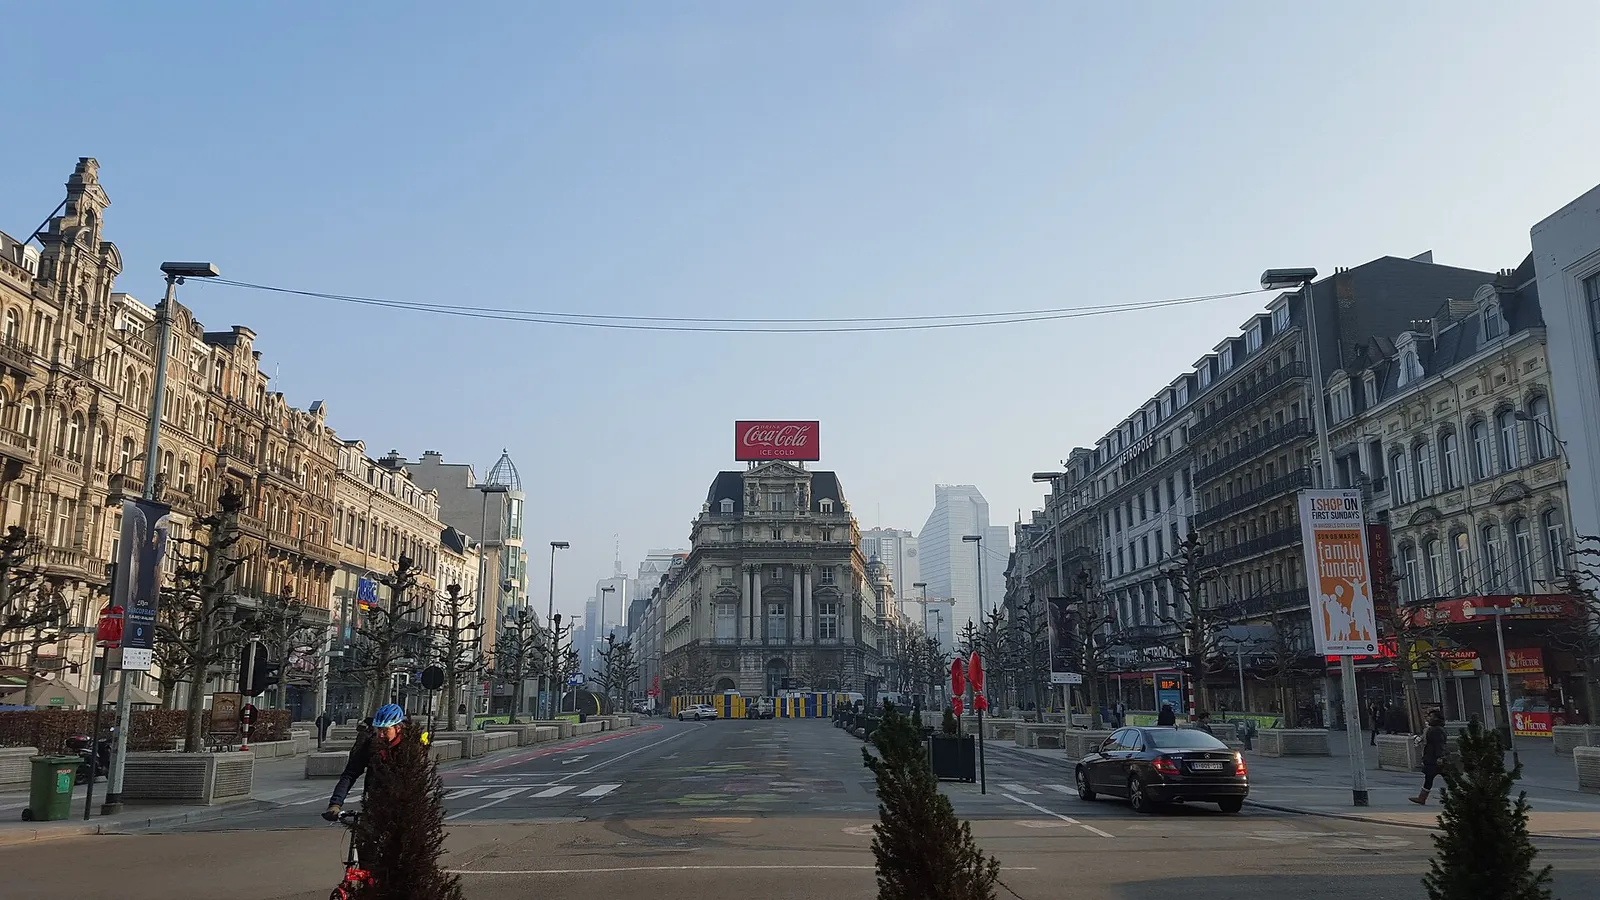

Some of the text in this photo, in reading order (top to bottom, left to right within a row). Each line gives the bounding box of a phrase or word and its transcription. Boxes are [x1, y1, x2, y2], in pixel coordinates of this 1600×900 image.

[743, 425, 811, 447] Coca-Cola
[1118, 434, 1153, 467] METROPOLE
[1310, 497, 1358, 511] I SHOP ON
[1311, 511, 1360, 520] FIRST SUNDAYS
[1318, 541, 1361, 563] family
[1320, 559, 1363, 580] funday
[1517, 652, 1540, 667] HECTOR
[1524, 715, 1547, 730] HECTOR
